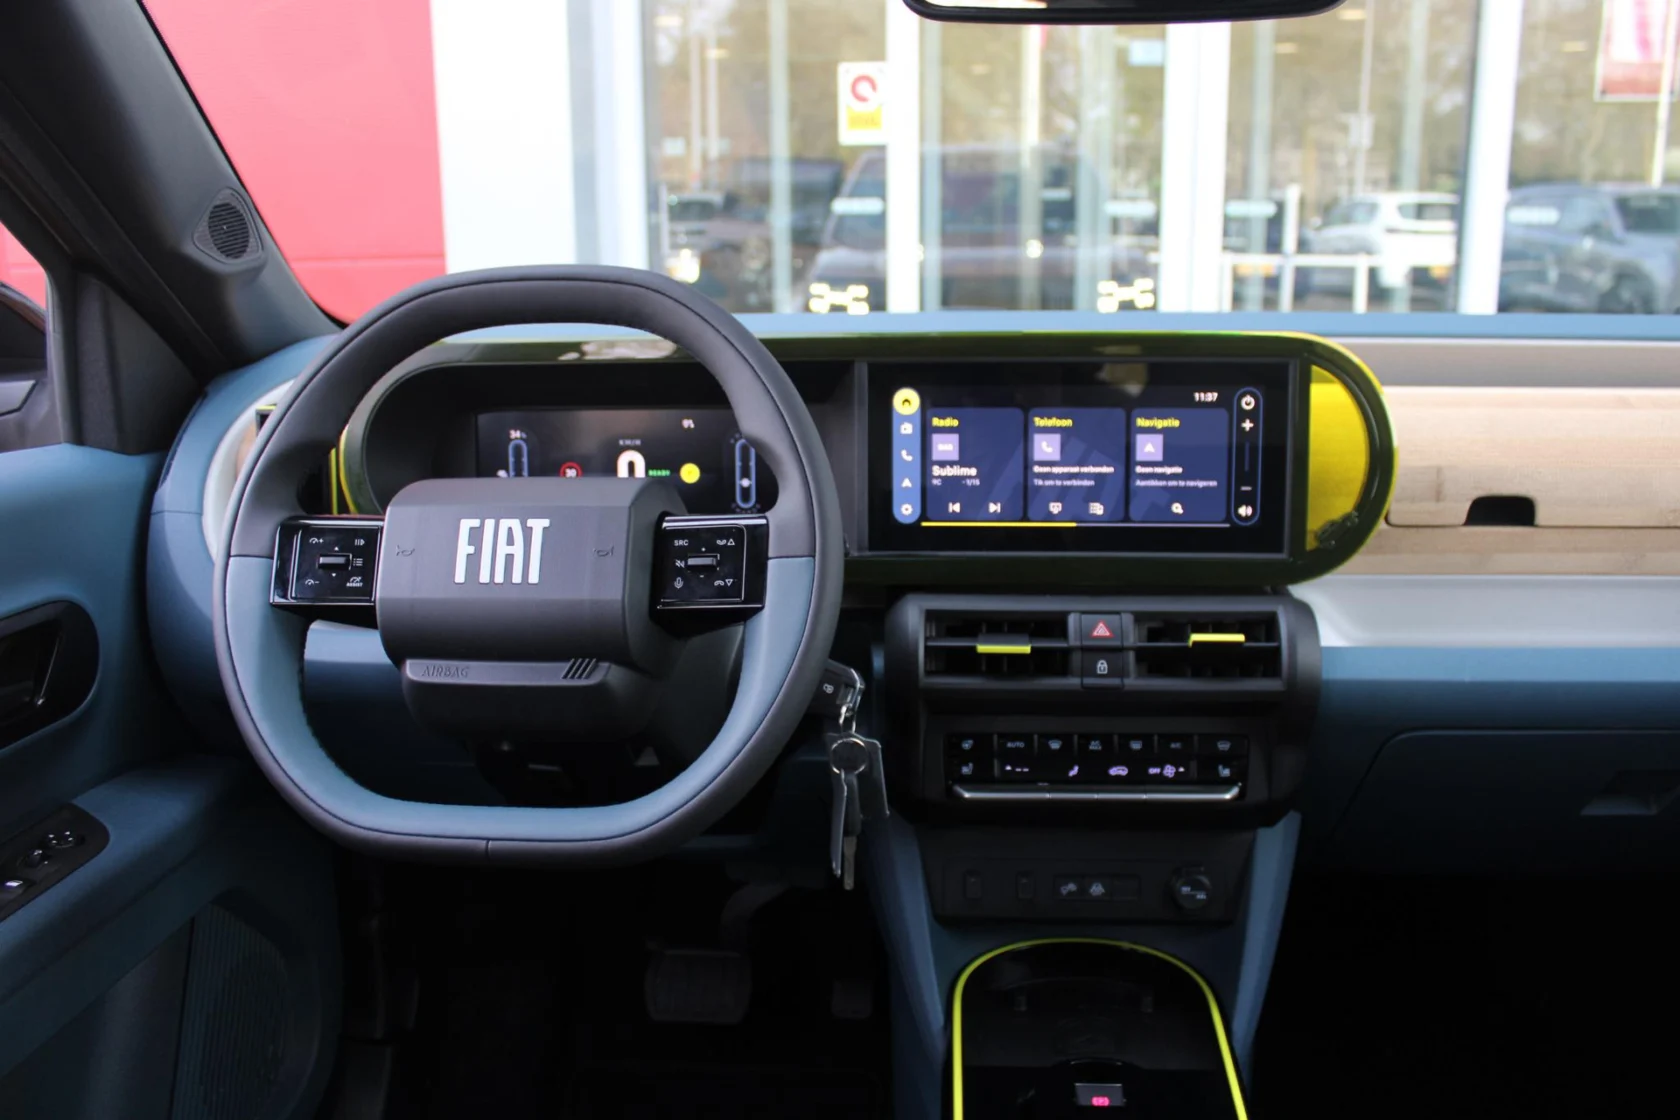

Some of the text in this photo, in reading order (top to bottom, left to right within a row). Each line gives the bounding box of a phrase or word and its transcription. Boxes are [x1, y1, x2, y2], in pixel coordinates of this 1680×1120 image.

[932, 417, 959, 427] Radio
[1033, 417, 1073, 427] Telefoon
[1136, 417, 1180, 429] Navigatie
[932, 465, 977, 476] Sublime
[454, 518, 550, 584] FIAT
[421, 665, 470, 678] AIRBAG
